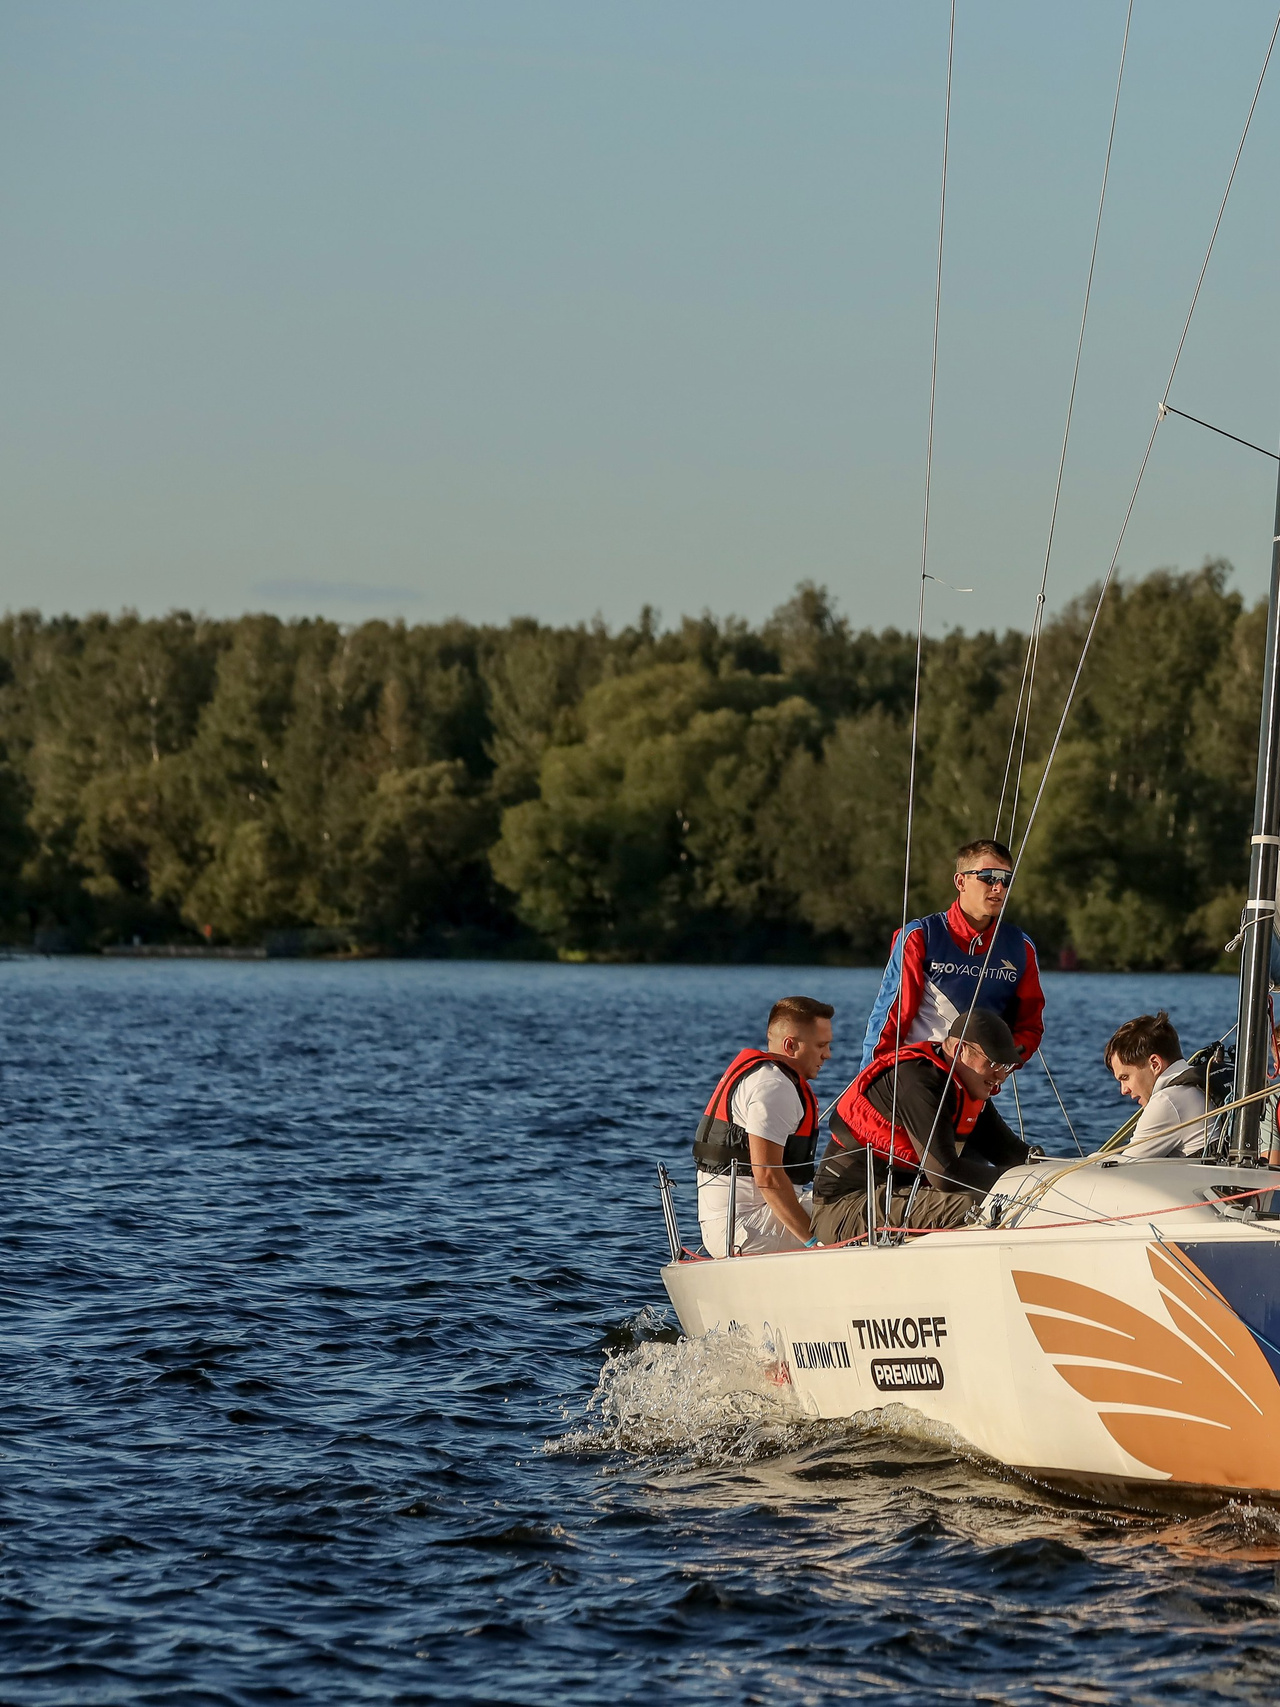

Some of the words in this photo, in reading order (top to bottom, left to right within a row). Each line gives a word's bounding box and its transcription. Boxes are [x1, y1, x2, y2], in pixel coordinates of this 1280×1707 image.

[852, 1317, 947, 1350] TINKOFF
[792, 1341, 851, 1370] ВЕДОМОСТИ
[874, 1363, 940, 1385] PREMIUM
